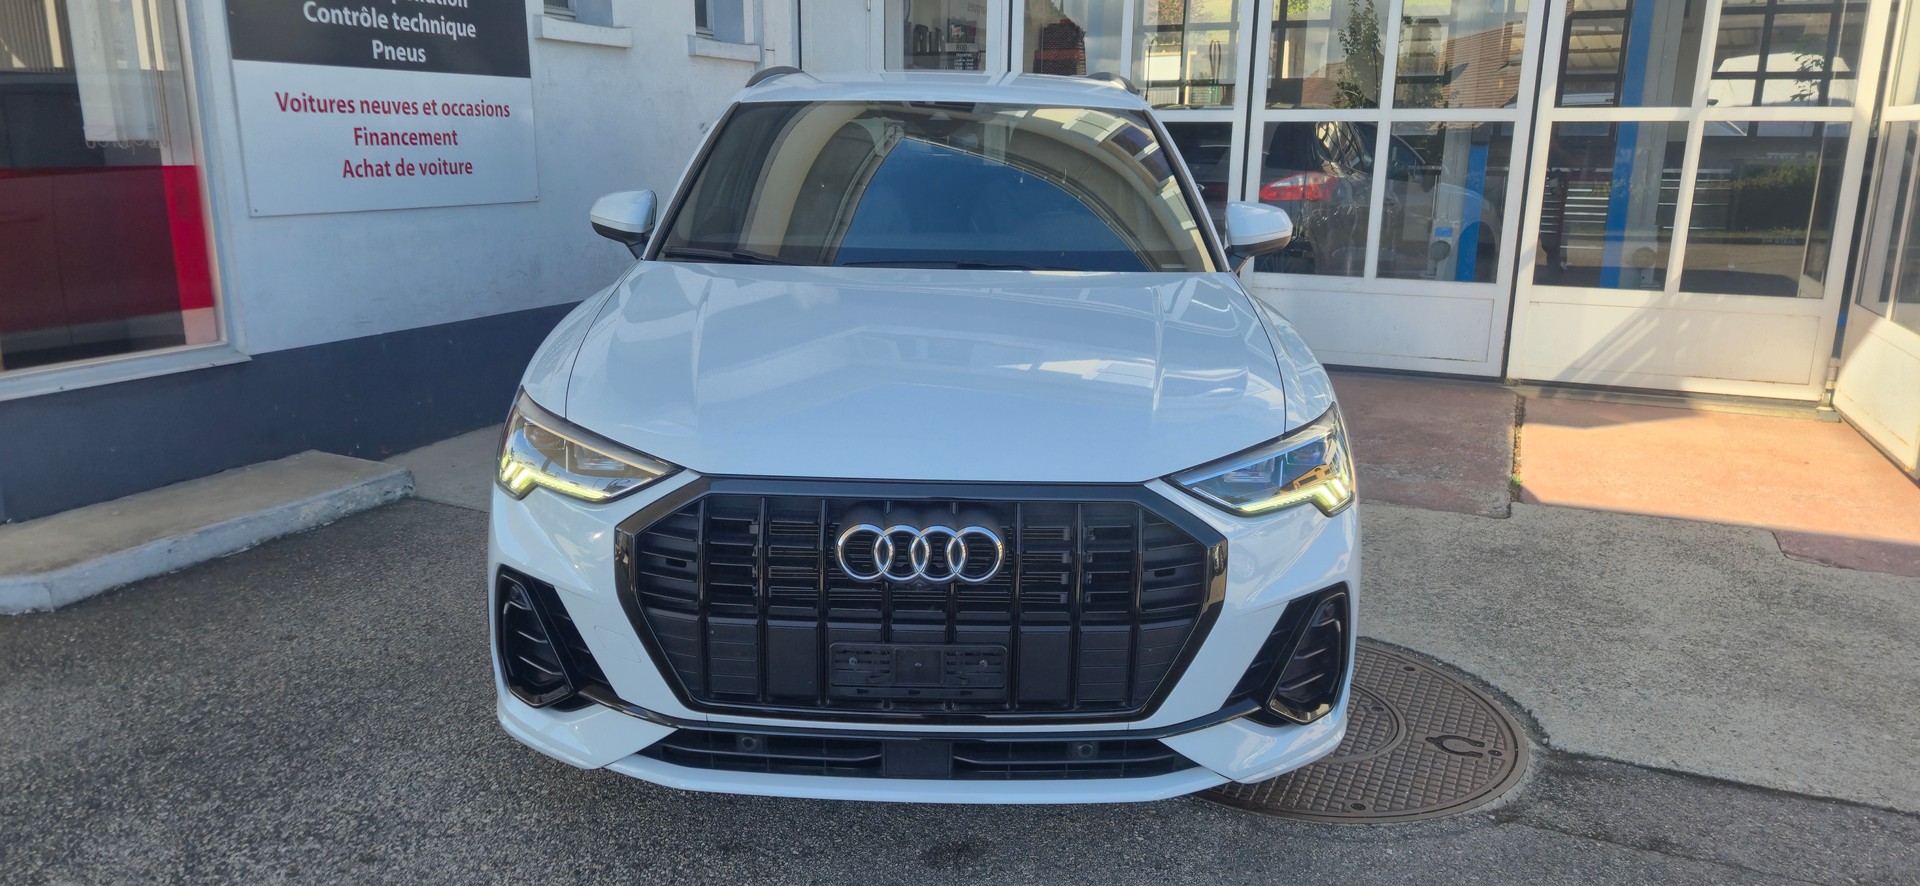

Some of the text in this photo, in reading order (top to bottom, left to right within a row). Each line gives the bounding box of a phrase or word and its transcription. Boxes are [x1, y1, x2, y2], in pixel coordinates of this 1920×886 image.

[303, 1, 477, 41] Contrôle technique
[371, 39, 427, 63] Pneus
[275, 92, 511, 118] Voitures neuves et occasions
[353, 127, 459, 147] Financement
[342, 158, 474, 179] Achat de voiture
